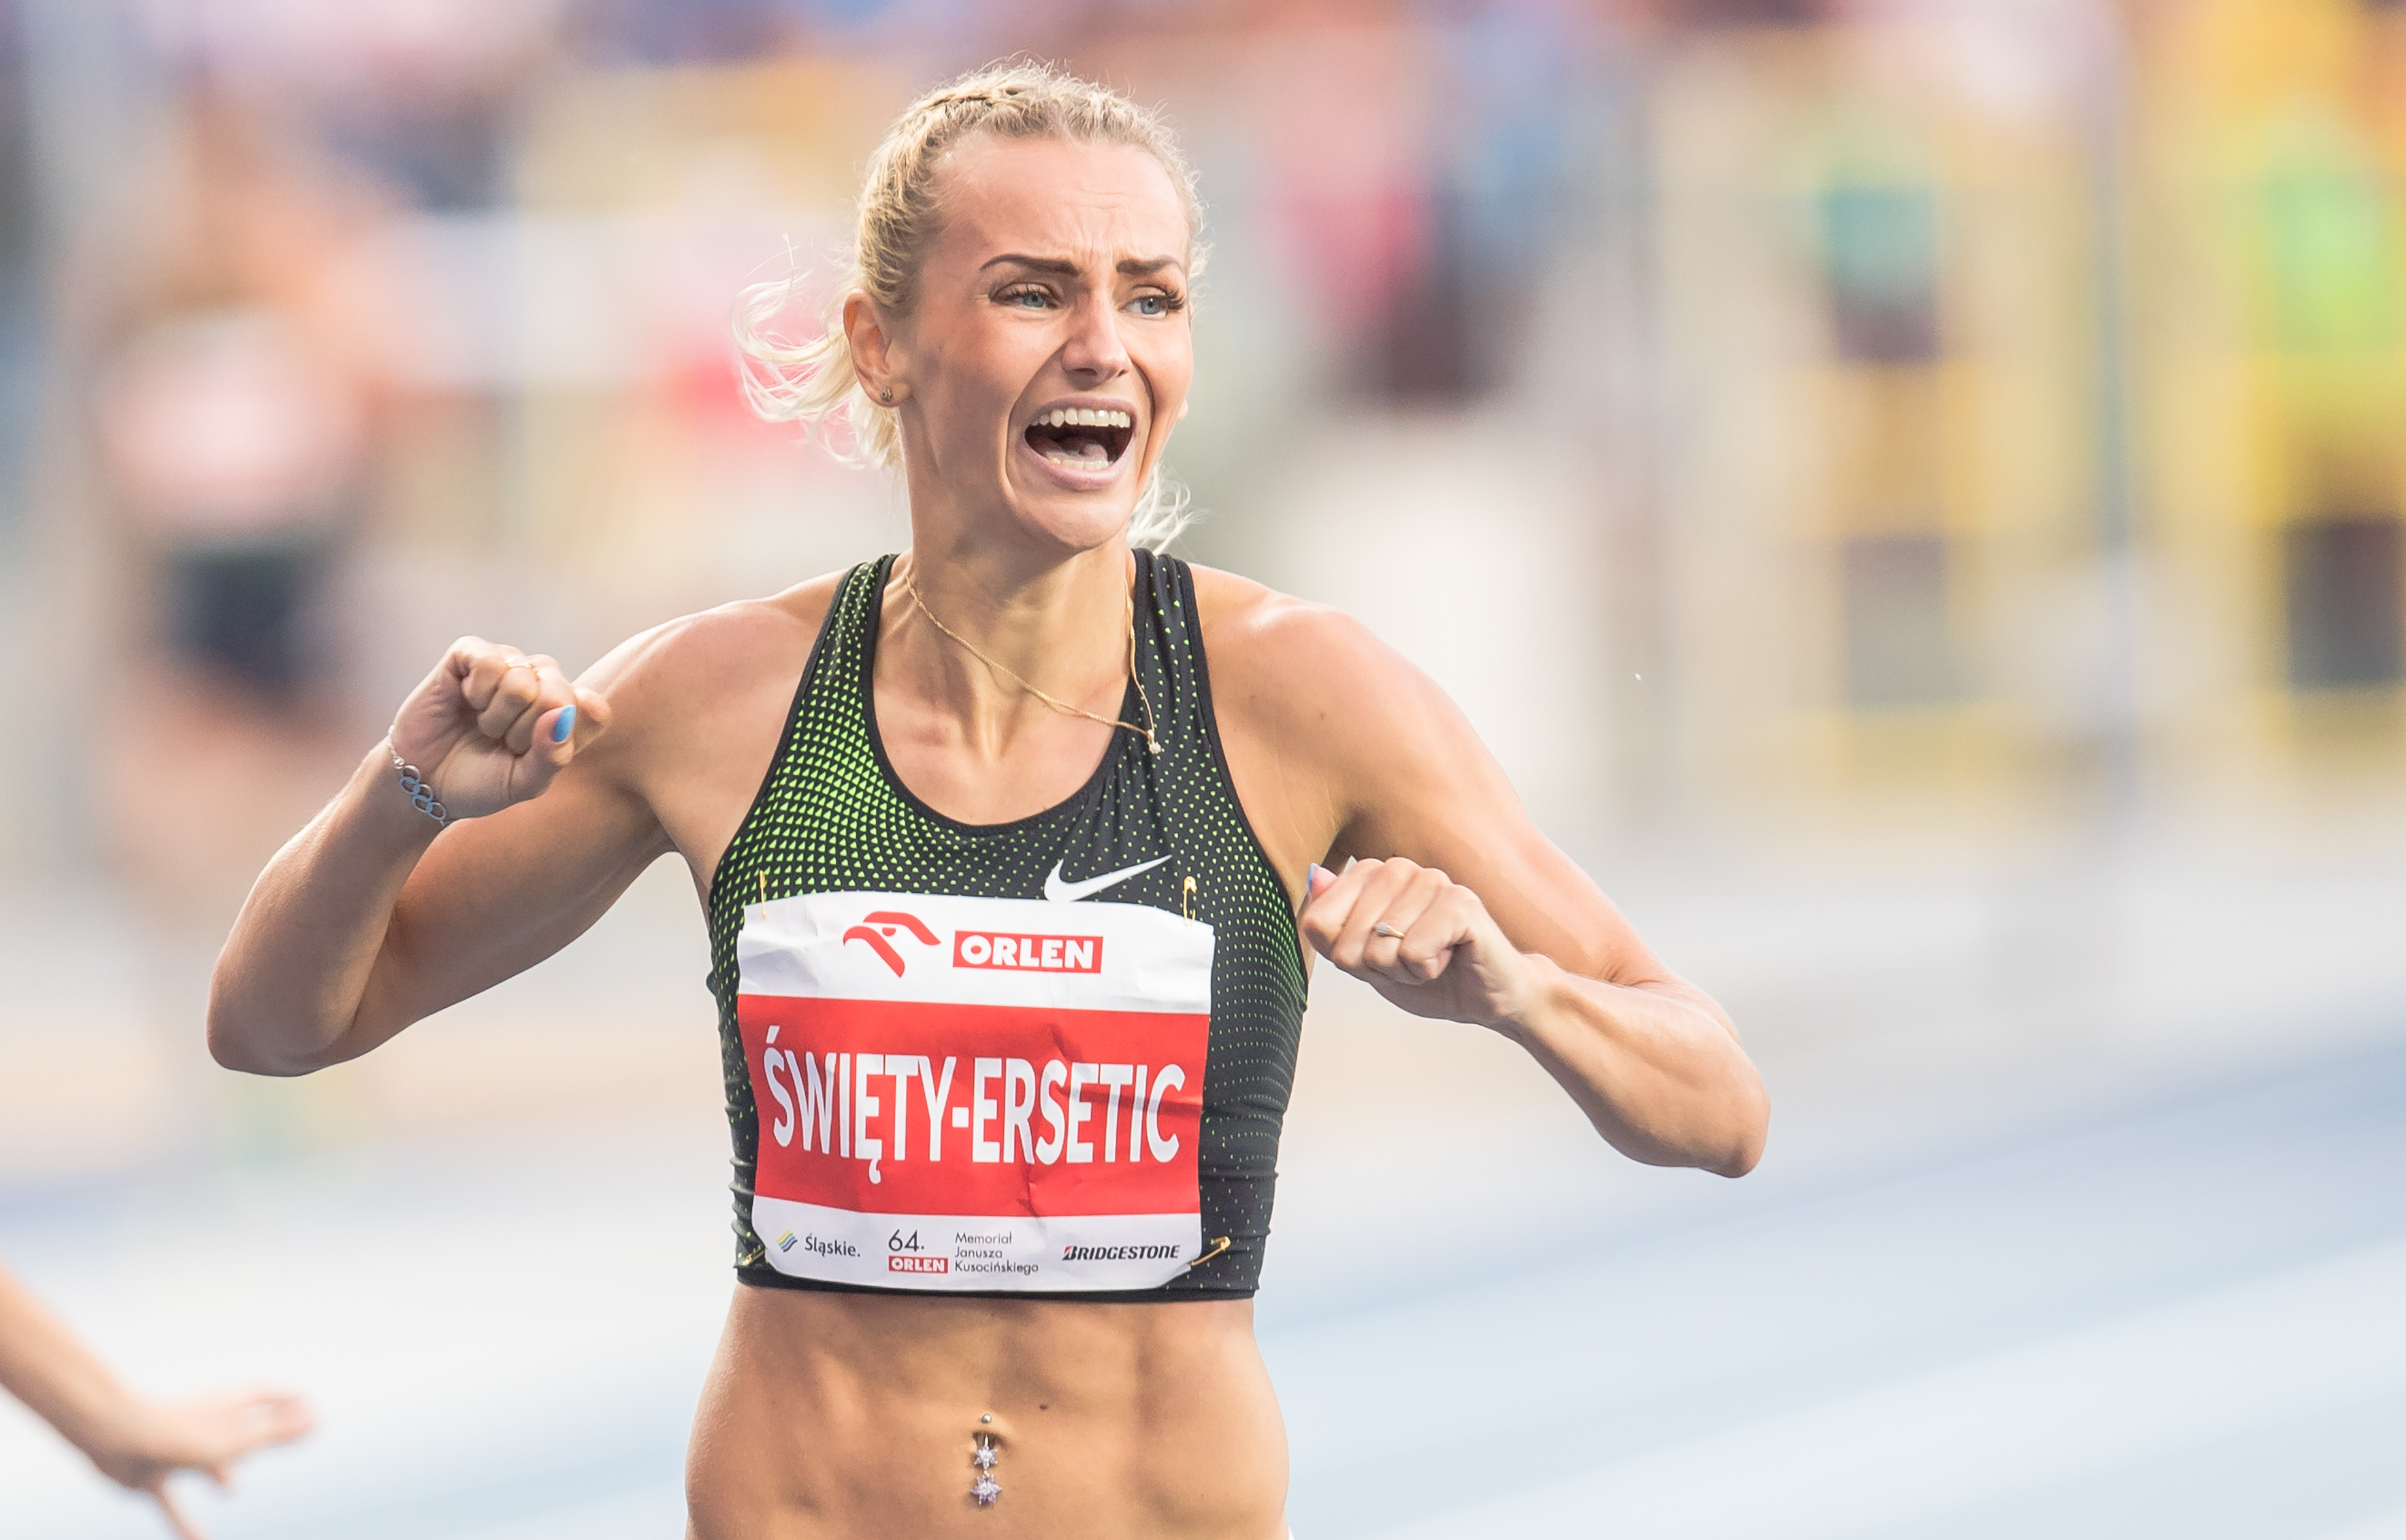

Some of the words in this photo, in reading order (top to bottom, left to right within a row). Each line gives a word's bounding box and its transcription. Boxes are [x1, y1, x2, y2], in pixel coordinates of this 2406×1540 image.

[960, 934, 1094, 969] ORLEN
[763, 1025, 1186, 1184] ŚWIĘTY-ERSETIC
[804, 1232, 861, 1258] Śląskie.
[888, 1228, 925, 1252] 64.
[954, 1231, 1012, 1245] Memoriał
[954, 1246, 1003, 1259] Janusza
[1062, 1244, 1181, 1261] BRIDGESTONE
[890, 1257, 945, 1273] ORLEN
[954, 1260, 1039, 1276] Kusocińskiego
